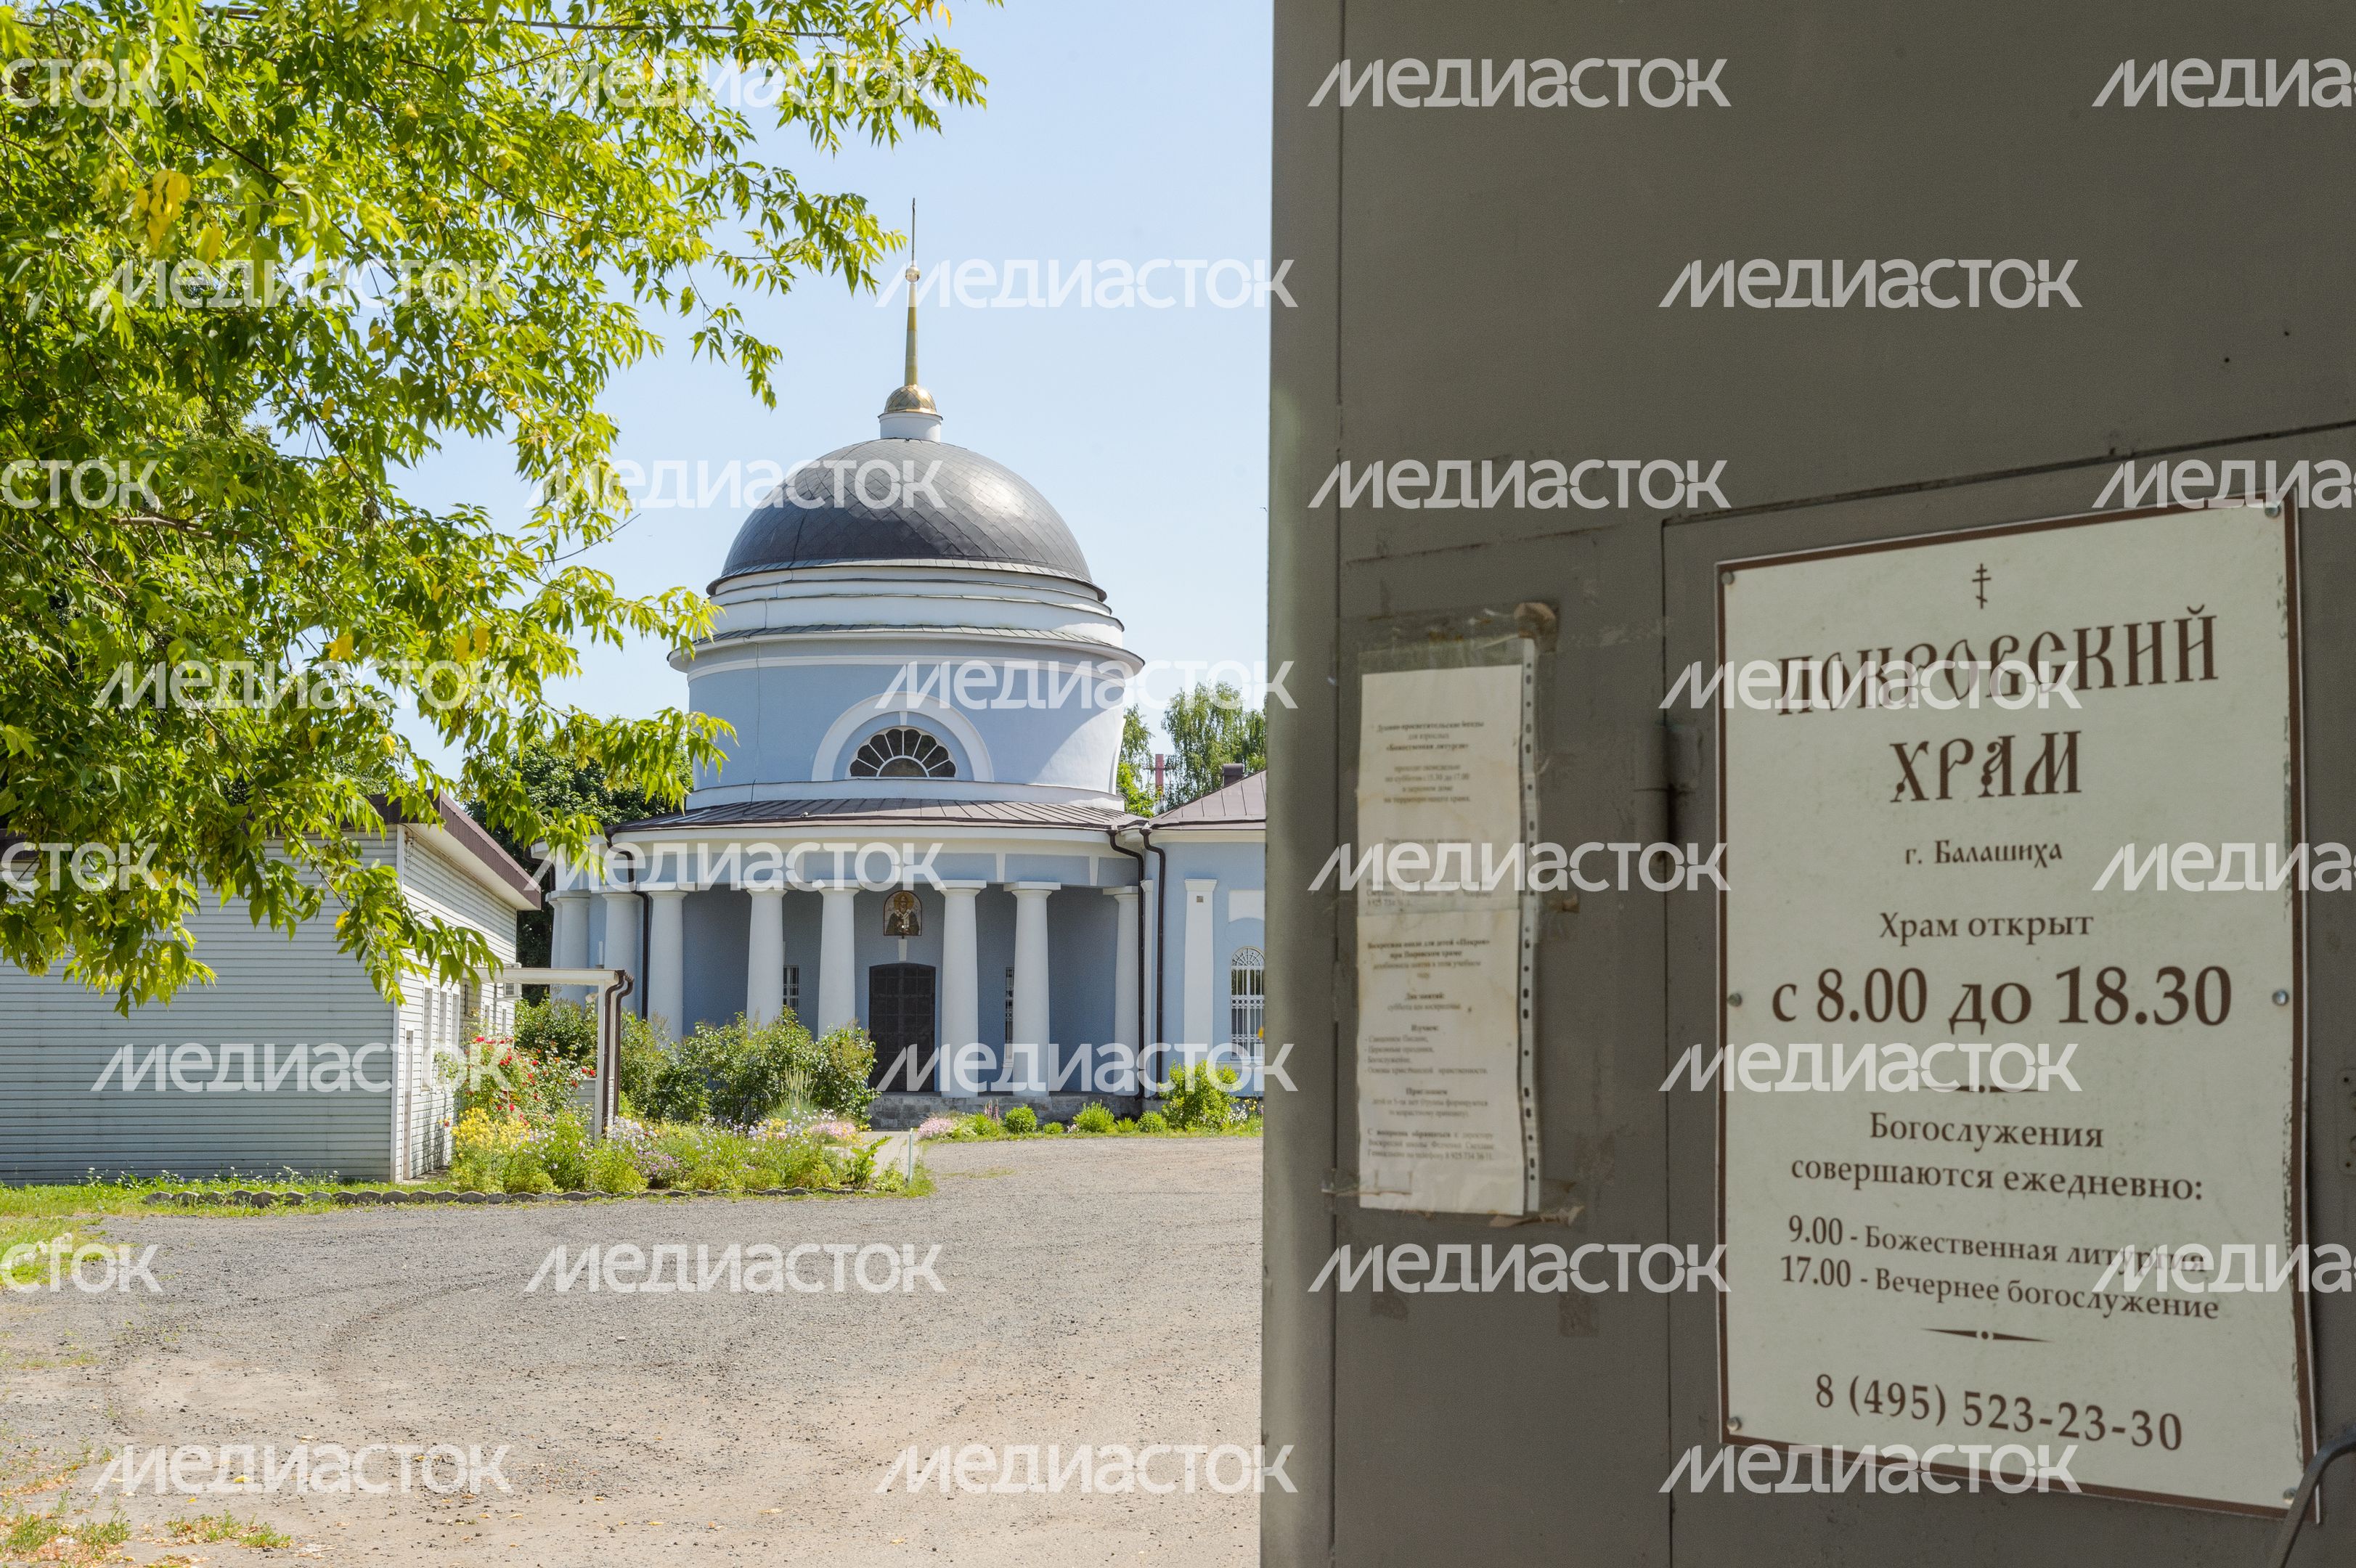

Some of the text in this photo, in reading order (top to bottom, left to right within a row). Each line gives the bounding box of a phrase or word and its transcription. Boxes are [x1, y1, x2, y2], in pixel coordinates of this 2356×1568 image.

[1777, 604, 2220, 716] ПОКРОВСКИЙ
[1890, 731, 2082, 802] ХРАМ
[1906, 840, 2062, 867] г. Балашиха
[1880, 912, 2093, 947] Храм открыт
[1772, 966, 2231, 1035] с 8.00 до 18.30
[1871, 1112, 2103, 1152] Богослужения
[1792, 1161, 2201, 1200] совершаются ежедневно:
[1789, 1215, 1843, 1245] 9.00
[1866, 1226, 2057, 1261] Божественная
[1782, 1256, 1851, 1287] 17.00
[1876, 1268, 1999, 1303] Вечернее
[2008, 1279, 2219, 1321] богослужение
[1817, 1374, 2182, 1450] 8 (495) 523-23-30
